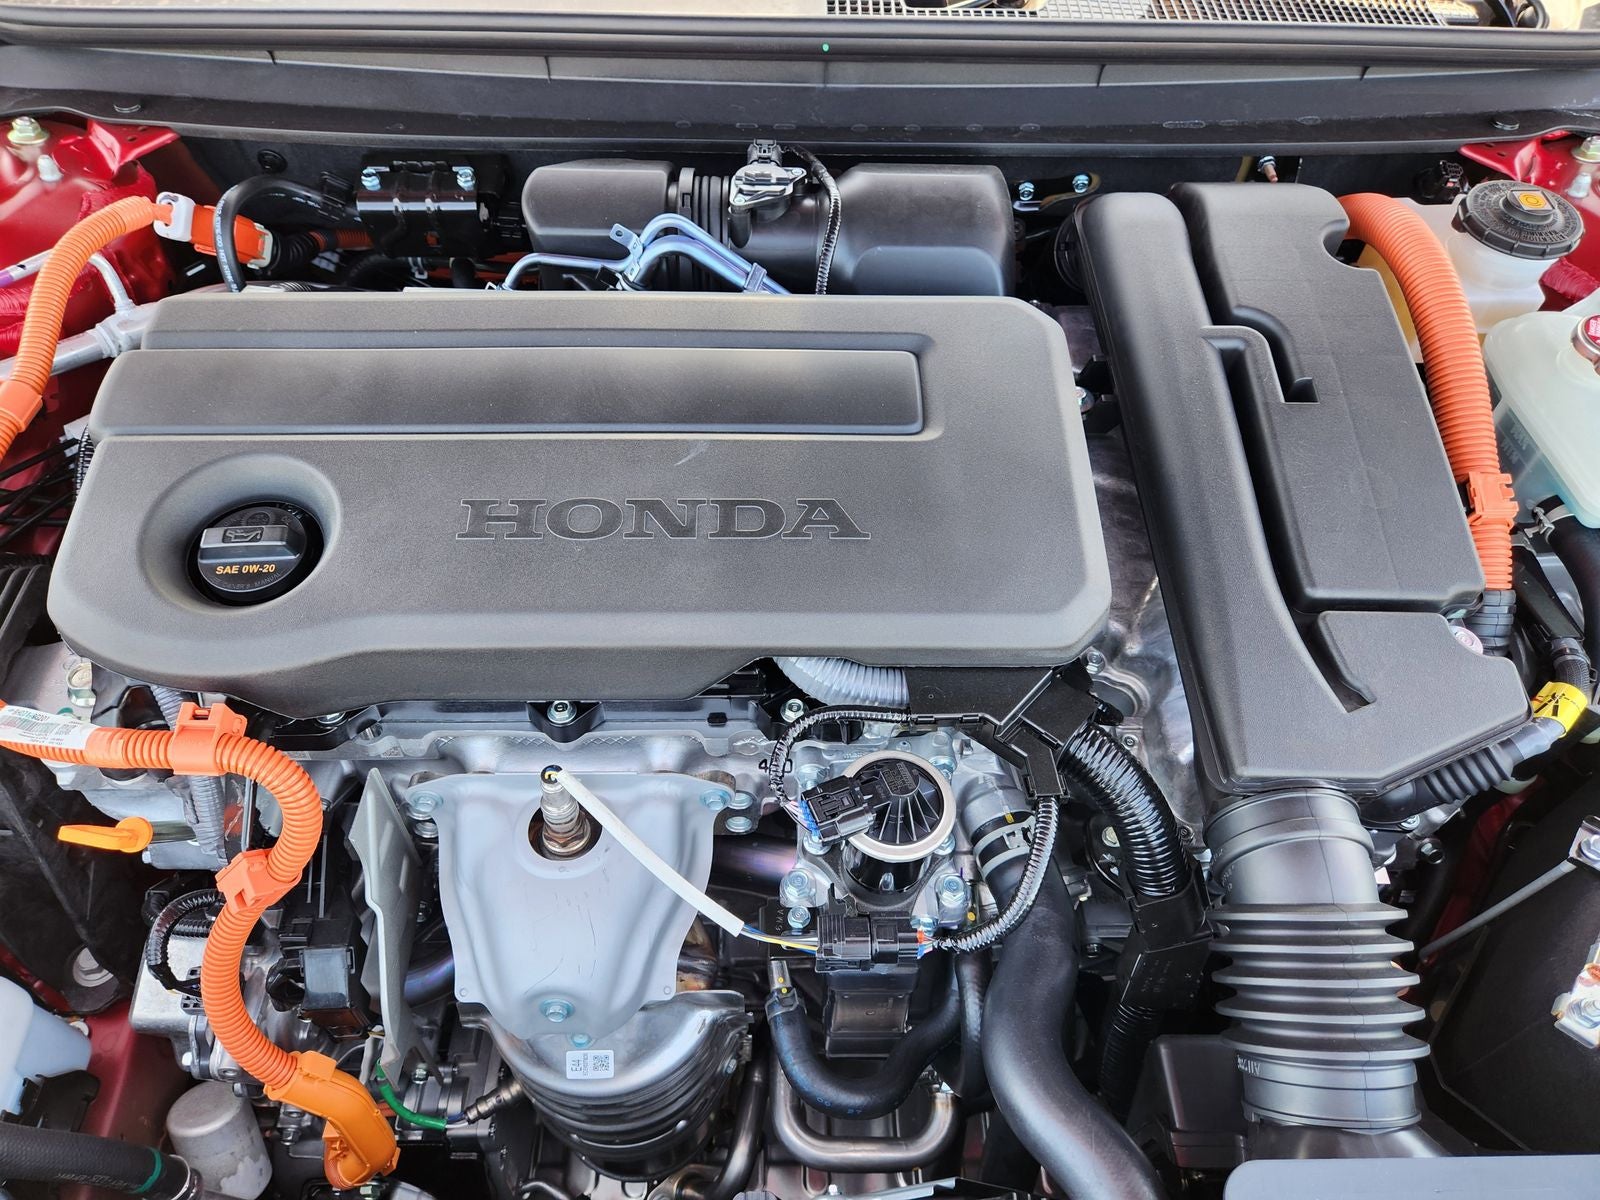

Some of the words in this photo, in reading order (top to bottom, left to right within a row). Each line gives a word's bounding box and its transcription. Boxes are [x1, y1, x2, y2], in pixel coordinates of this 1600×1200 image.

[455, 497, 872, 541] HONDA
[215, 565, 240, 575] SAE
[241, 564, 276, 574] 0W-20
[570, 1059, 583, 1072] E44
